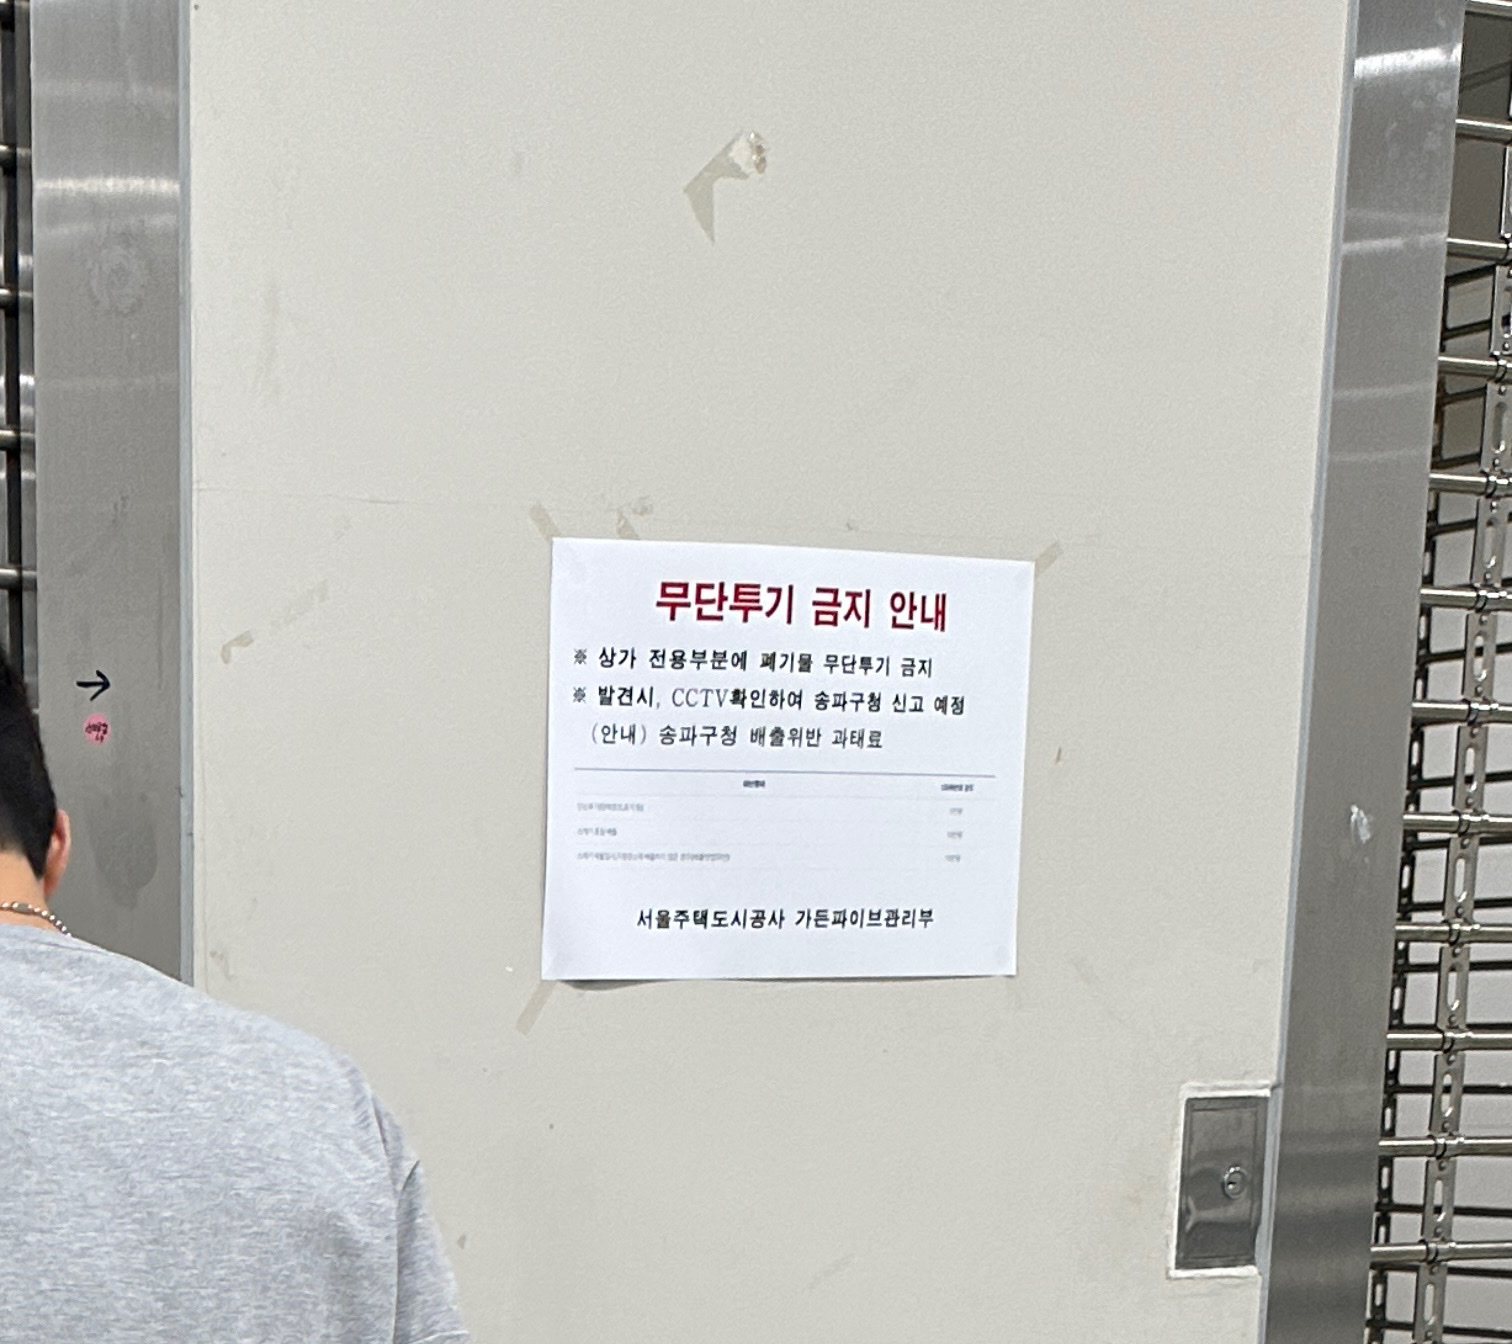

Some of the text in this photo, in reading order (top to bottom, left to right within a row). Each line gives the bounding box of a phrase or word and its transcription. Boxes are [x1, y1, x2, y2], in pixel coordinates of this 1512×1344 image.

[656, 581, 947, 632] 무단투기 금지 안내
[599, 647, 636, 669] 상가
[649, 649, 748, 671] 전용부분에
[823, 654, 890, 677] 무단투기
[901, 658, 933, 678] 금지
[672, 688, 803, 710] CCTV확인하여
[814, 690, 882, 712] 송파구청
[892, 693, 924, 713] 신고
[934, 695, 965, 715] 예정
[592, 723, 883, 749] (안내) 송파구청 배출위반 과태료
[637, 908, 934, 930] 서울주택도시공사 가든파이브관리부
